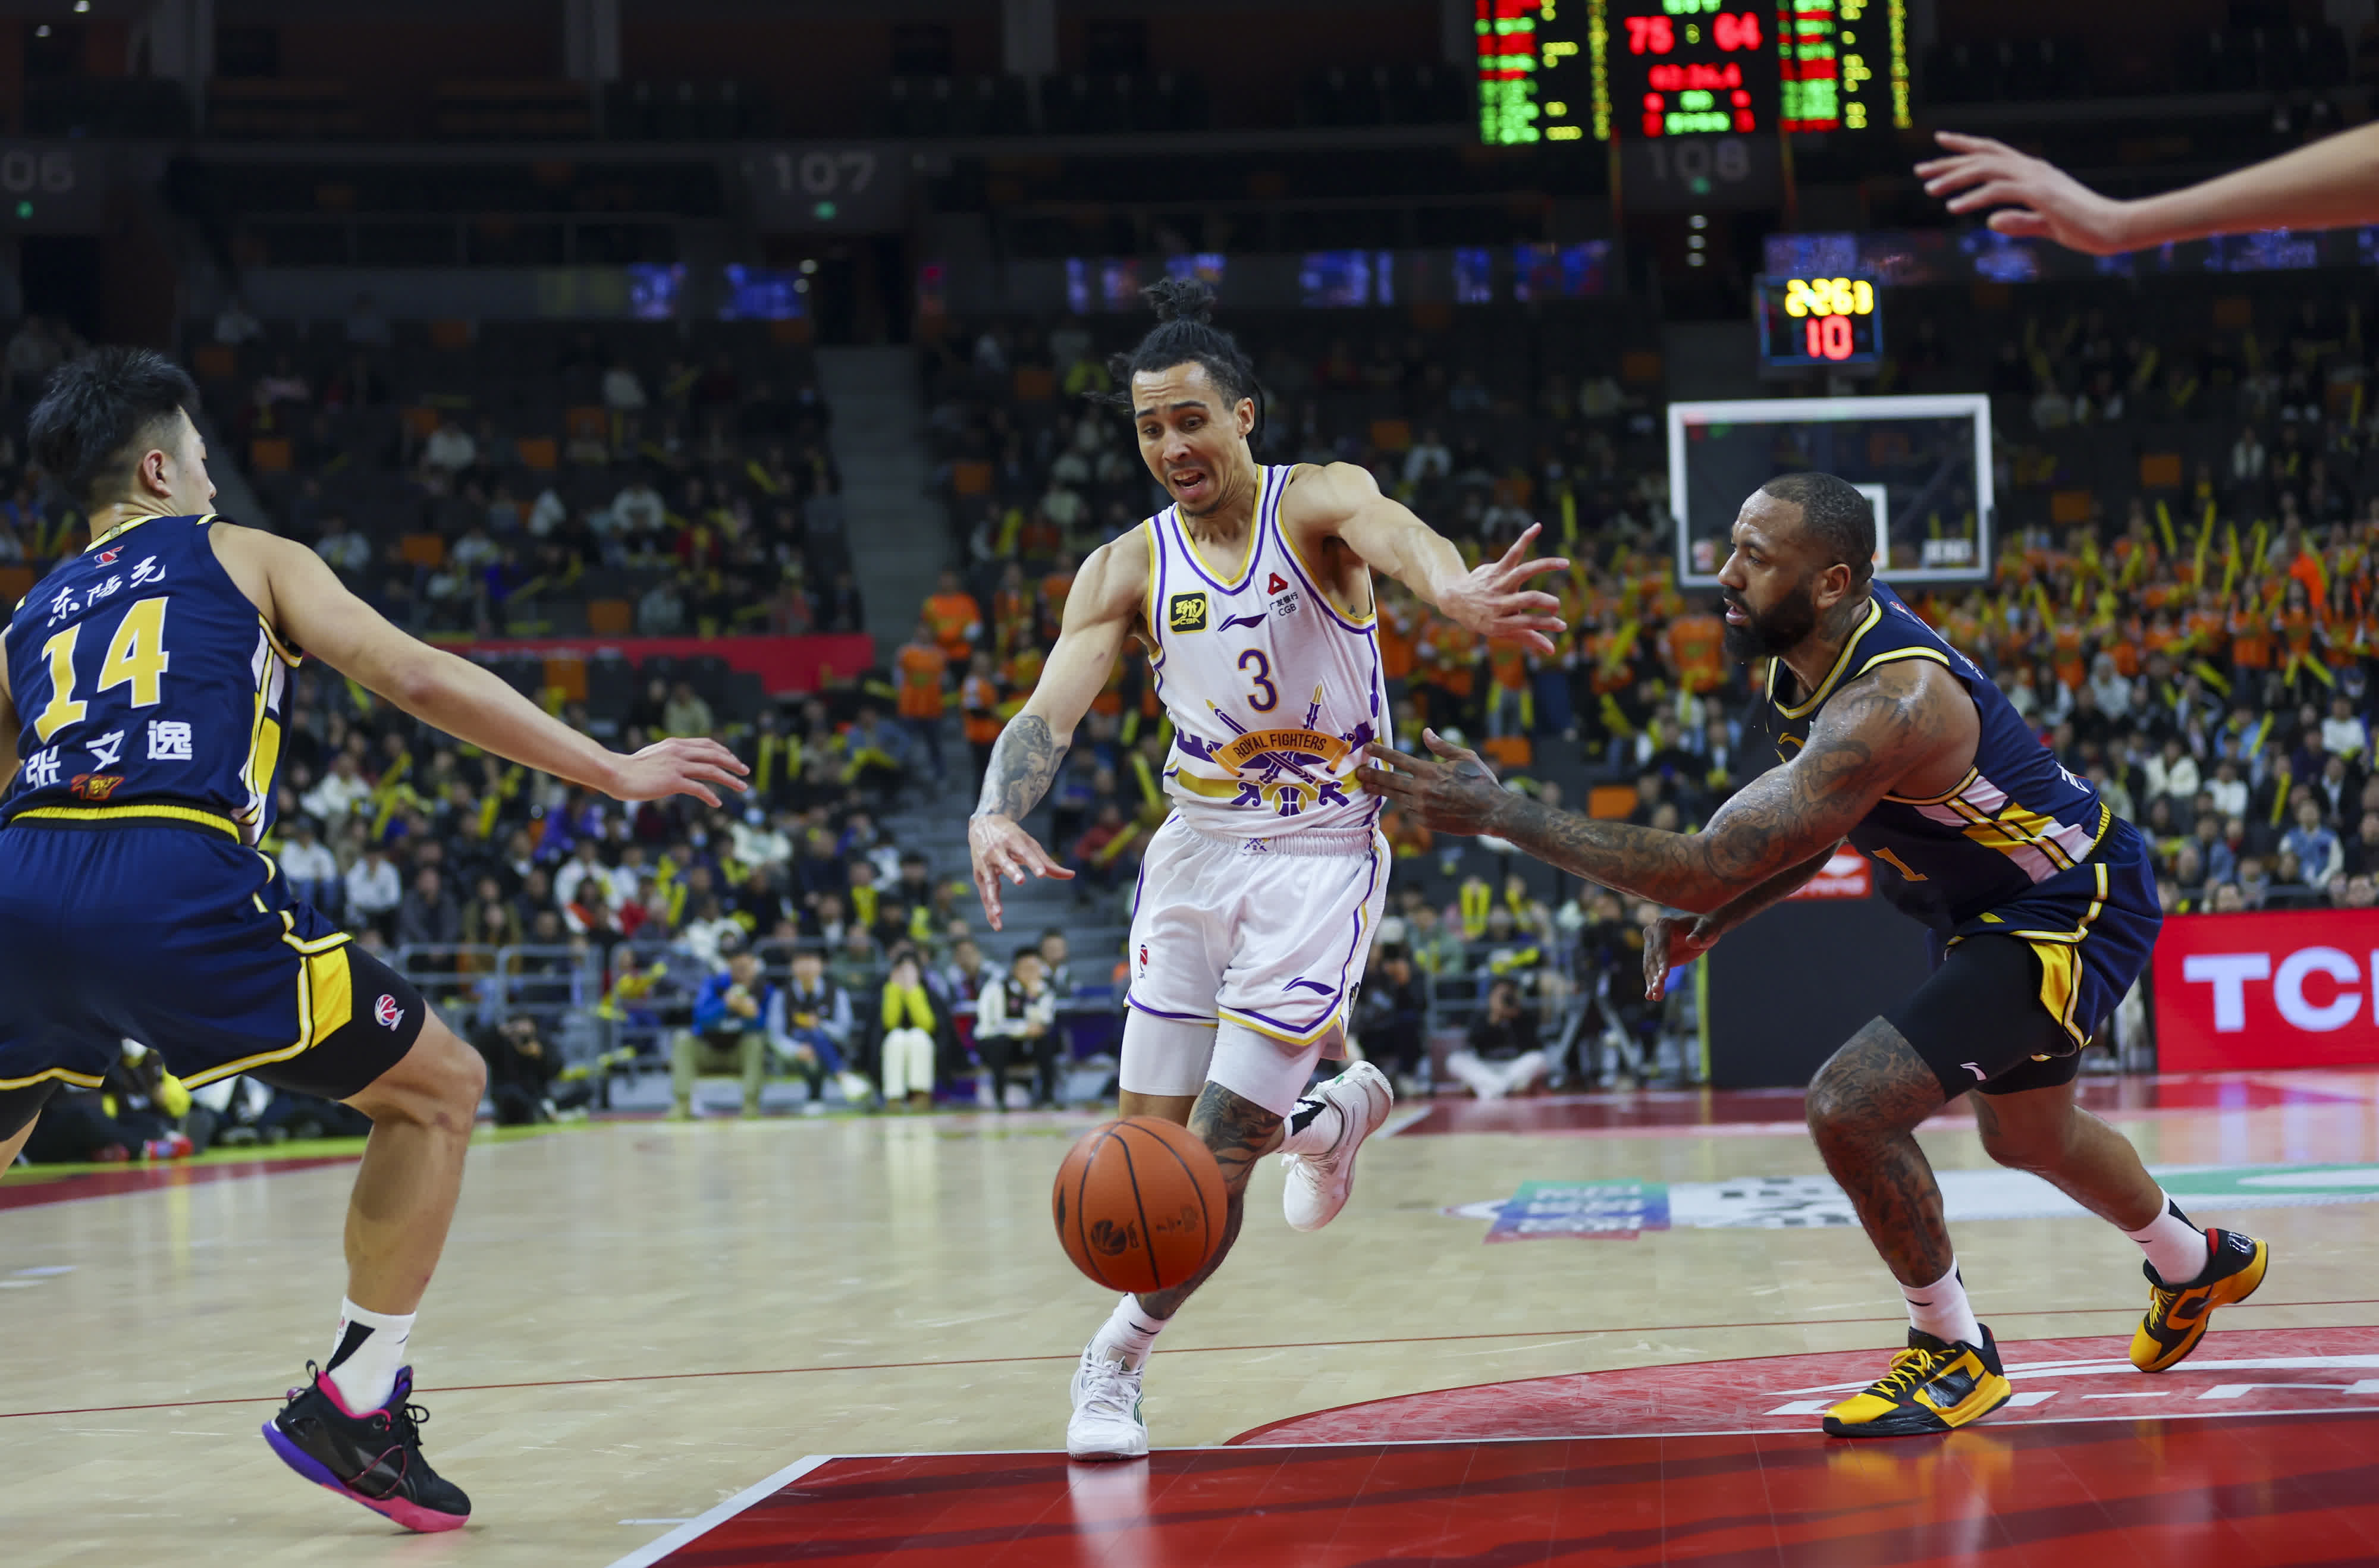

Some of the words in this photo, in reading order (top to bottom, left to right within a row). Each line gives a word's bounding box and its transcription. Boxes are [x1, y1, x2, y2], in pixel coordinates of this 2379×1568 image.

[773, 151, 877, 194] 107
[1806, 315, 1854, 360] 10
[1179, 617, 1201, 626] CBA
[1269, 592, 1299, 611] 广发银行
[1278, 604, 1297, 616] CGB
[34, 596, 170, 744] 14
[1236, 649, 1279, 714] 3
[26, 719, 193, 790] 张文逸
[1232, 735, 1269, 759] ROYAL
[1269, 733, 1327, 751] FIGHTERS
[2182, 945, 2379, 1033] TC
